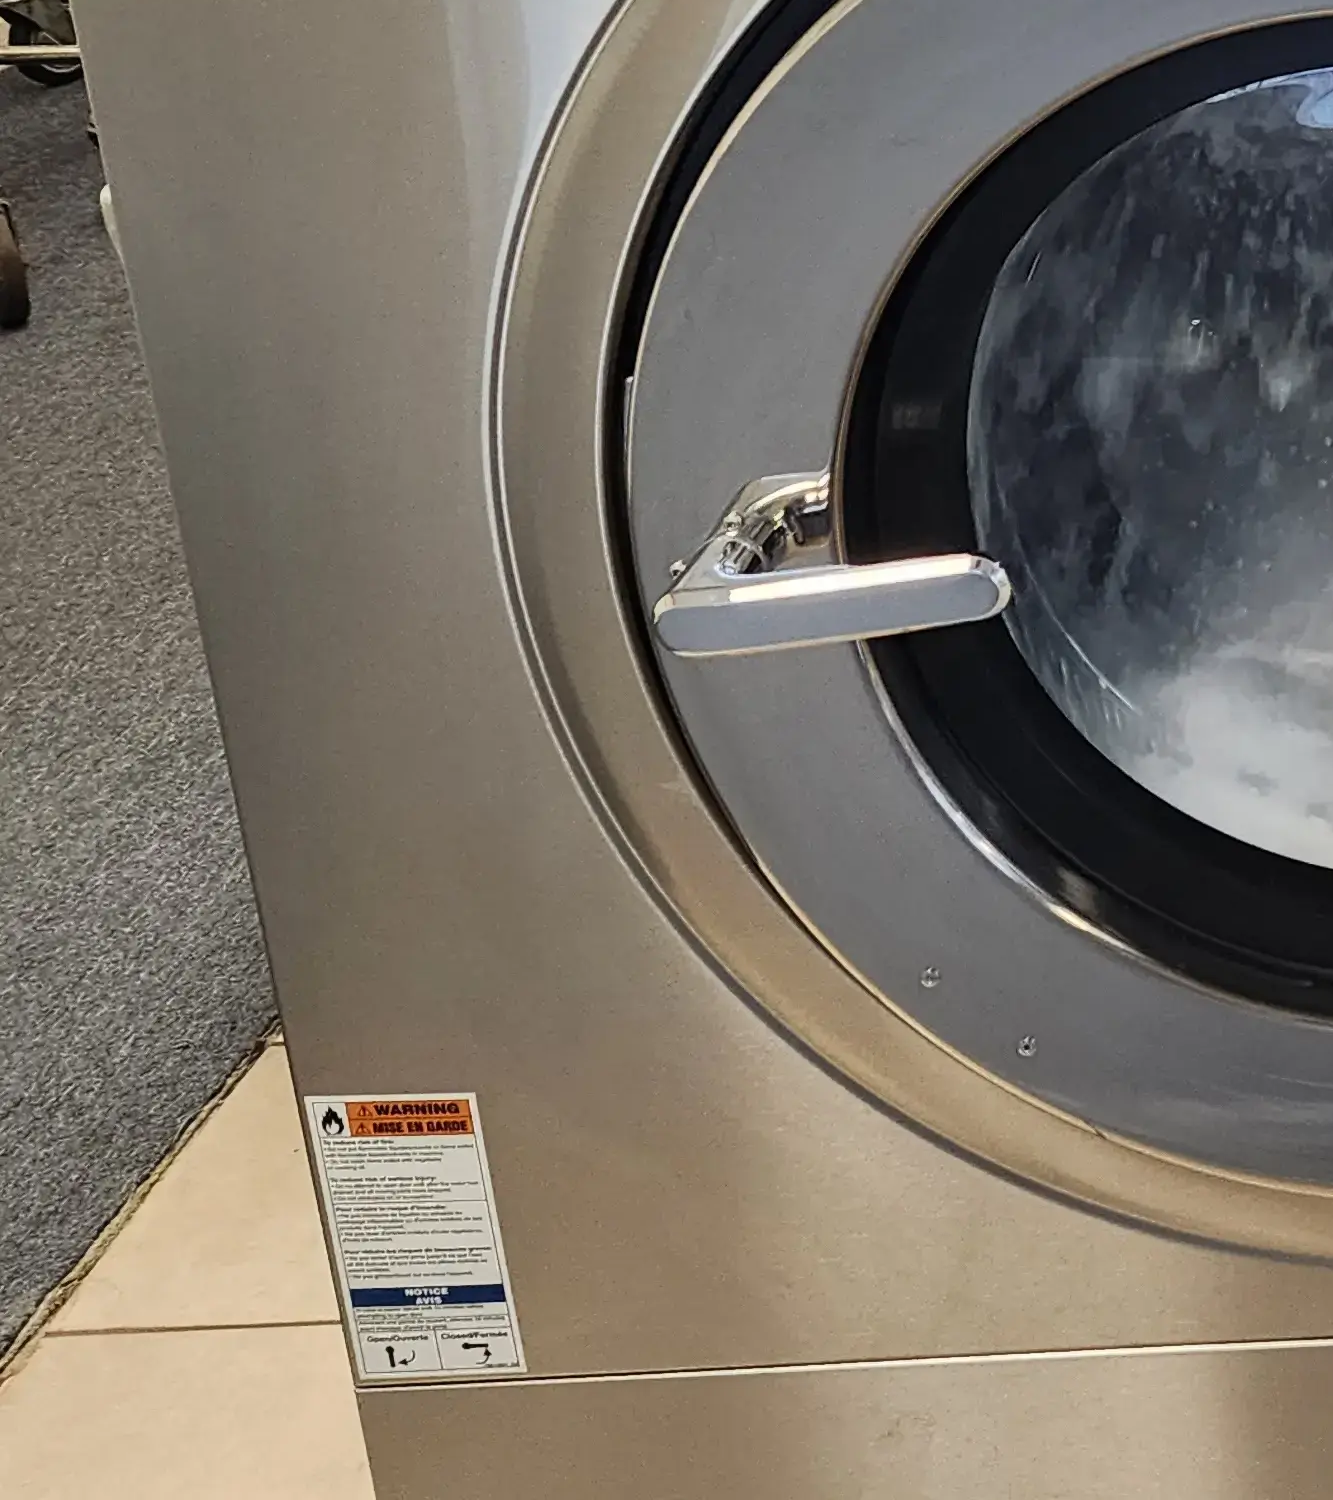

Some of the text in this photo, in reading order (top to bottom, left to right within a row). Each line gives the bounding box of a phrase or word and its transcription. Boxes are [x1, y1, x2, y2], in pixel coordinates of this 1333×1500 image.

[373, 1102, 460, 1116] WARNING
[373, 1119, 468, 1134] MISE EN GARDE
[405, 1287, 449, 1296] NOTICE
[415, 1296, 443, 1305] AVIS
